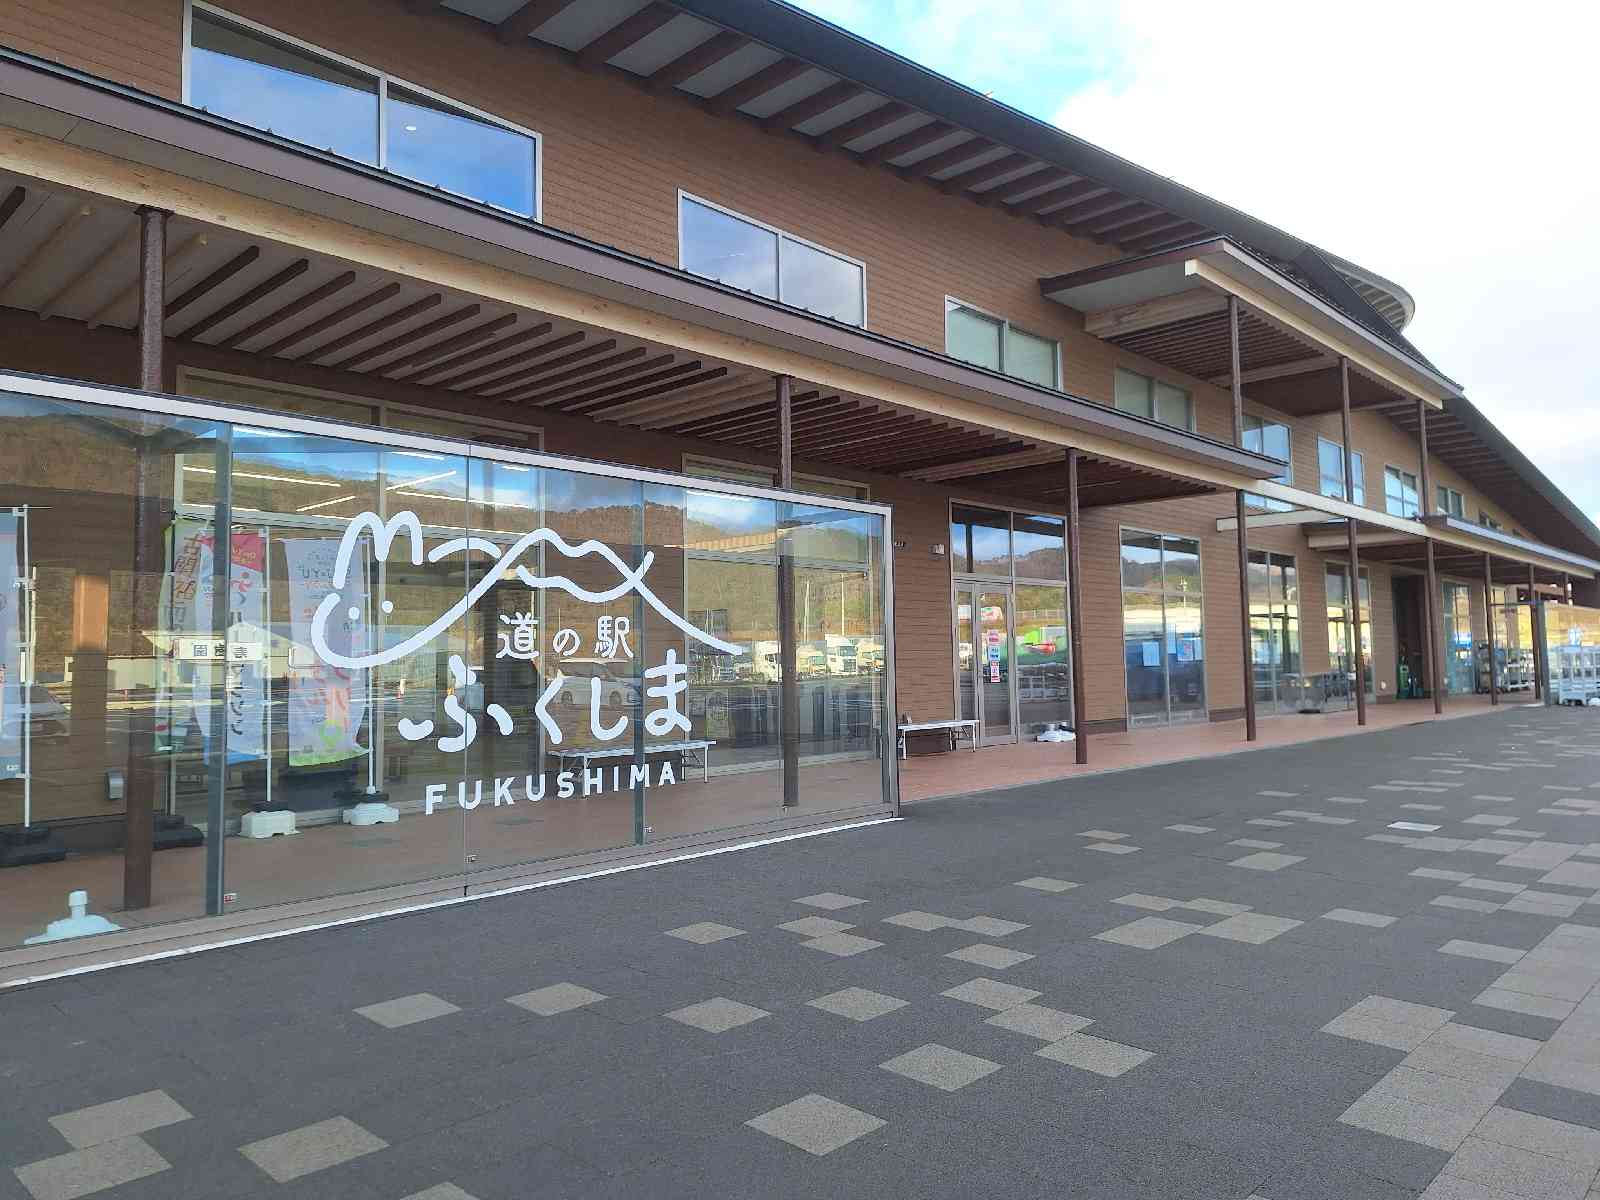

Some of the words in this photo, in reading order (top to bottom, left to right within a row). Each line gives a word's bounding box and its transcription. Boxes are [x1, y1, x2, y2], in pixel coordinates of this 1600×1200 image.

[497, 613, 633, 659] 道の駅
[398, 649, 692, 752] ふくしま
[425, 762, 676, 815] FUKUSHIMA
